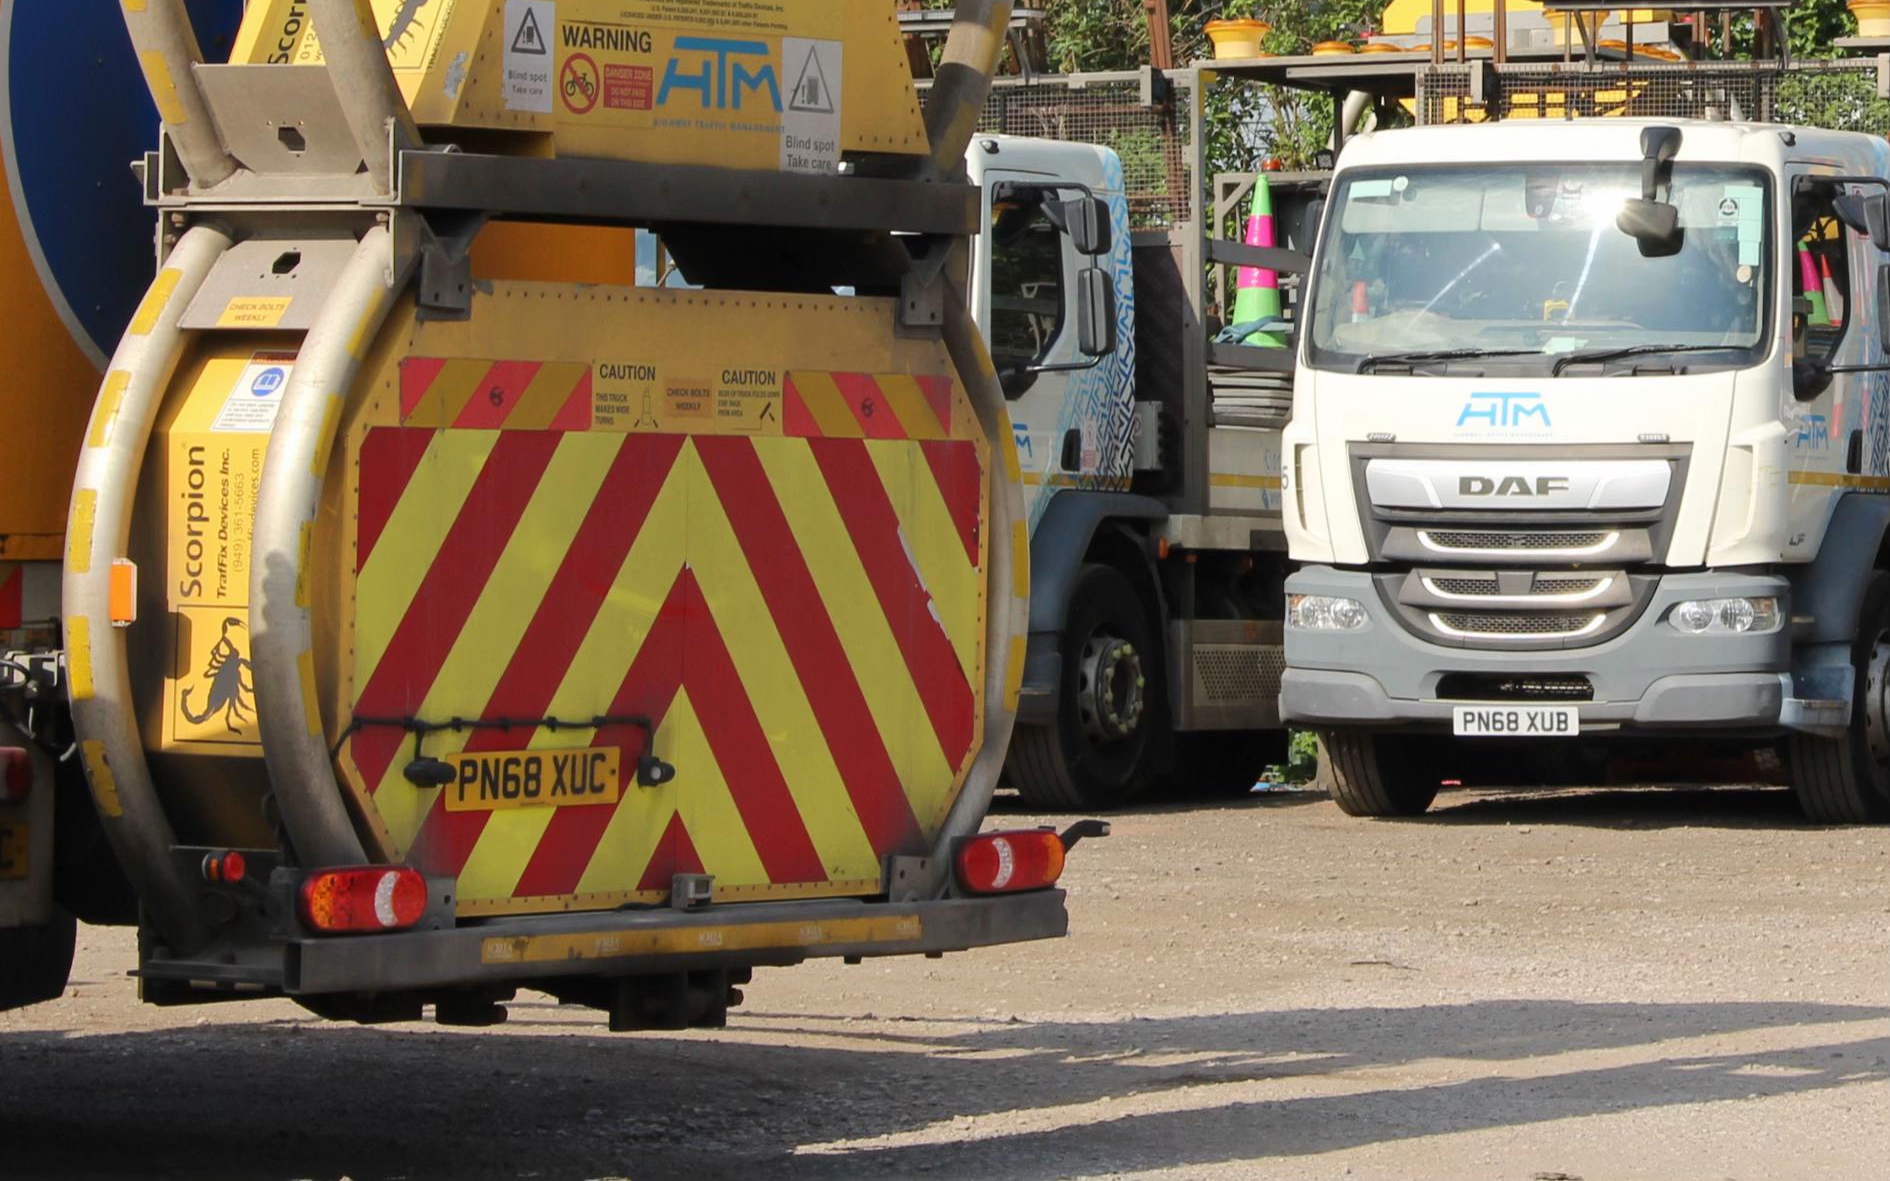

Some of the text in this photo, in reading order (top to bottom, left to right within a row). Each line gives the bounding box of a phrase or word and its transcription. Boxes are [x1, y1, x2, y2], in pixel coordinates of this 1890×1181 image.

[562, 25, 652, 53] WARNING
[509, 70, 547, 83] Blind spot
[656, 36, 784, 113] HTM
[512, 84, 543, 96] Take care
[785, 135, 835, 154] Blind spot
[786, 154, 832, 170] Take care
[599, 363, 656, 381] CAUTION
[722, 369, 776, 386] CAUTION
[1455, 392, 1552, 427] HTM
[1459, 476, 1569, 496] DAF
[179, 446, 209, 598] Scorpion
[217, 448, 230, 599] TrafFix Devices Inc.
[232, 472, 245, 573] (949) 361-5663
[1463, 711, 1569, 732] PN68 XUB
[458, 752, 607, 802] PN68 XUC
